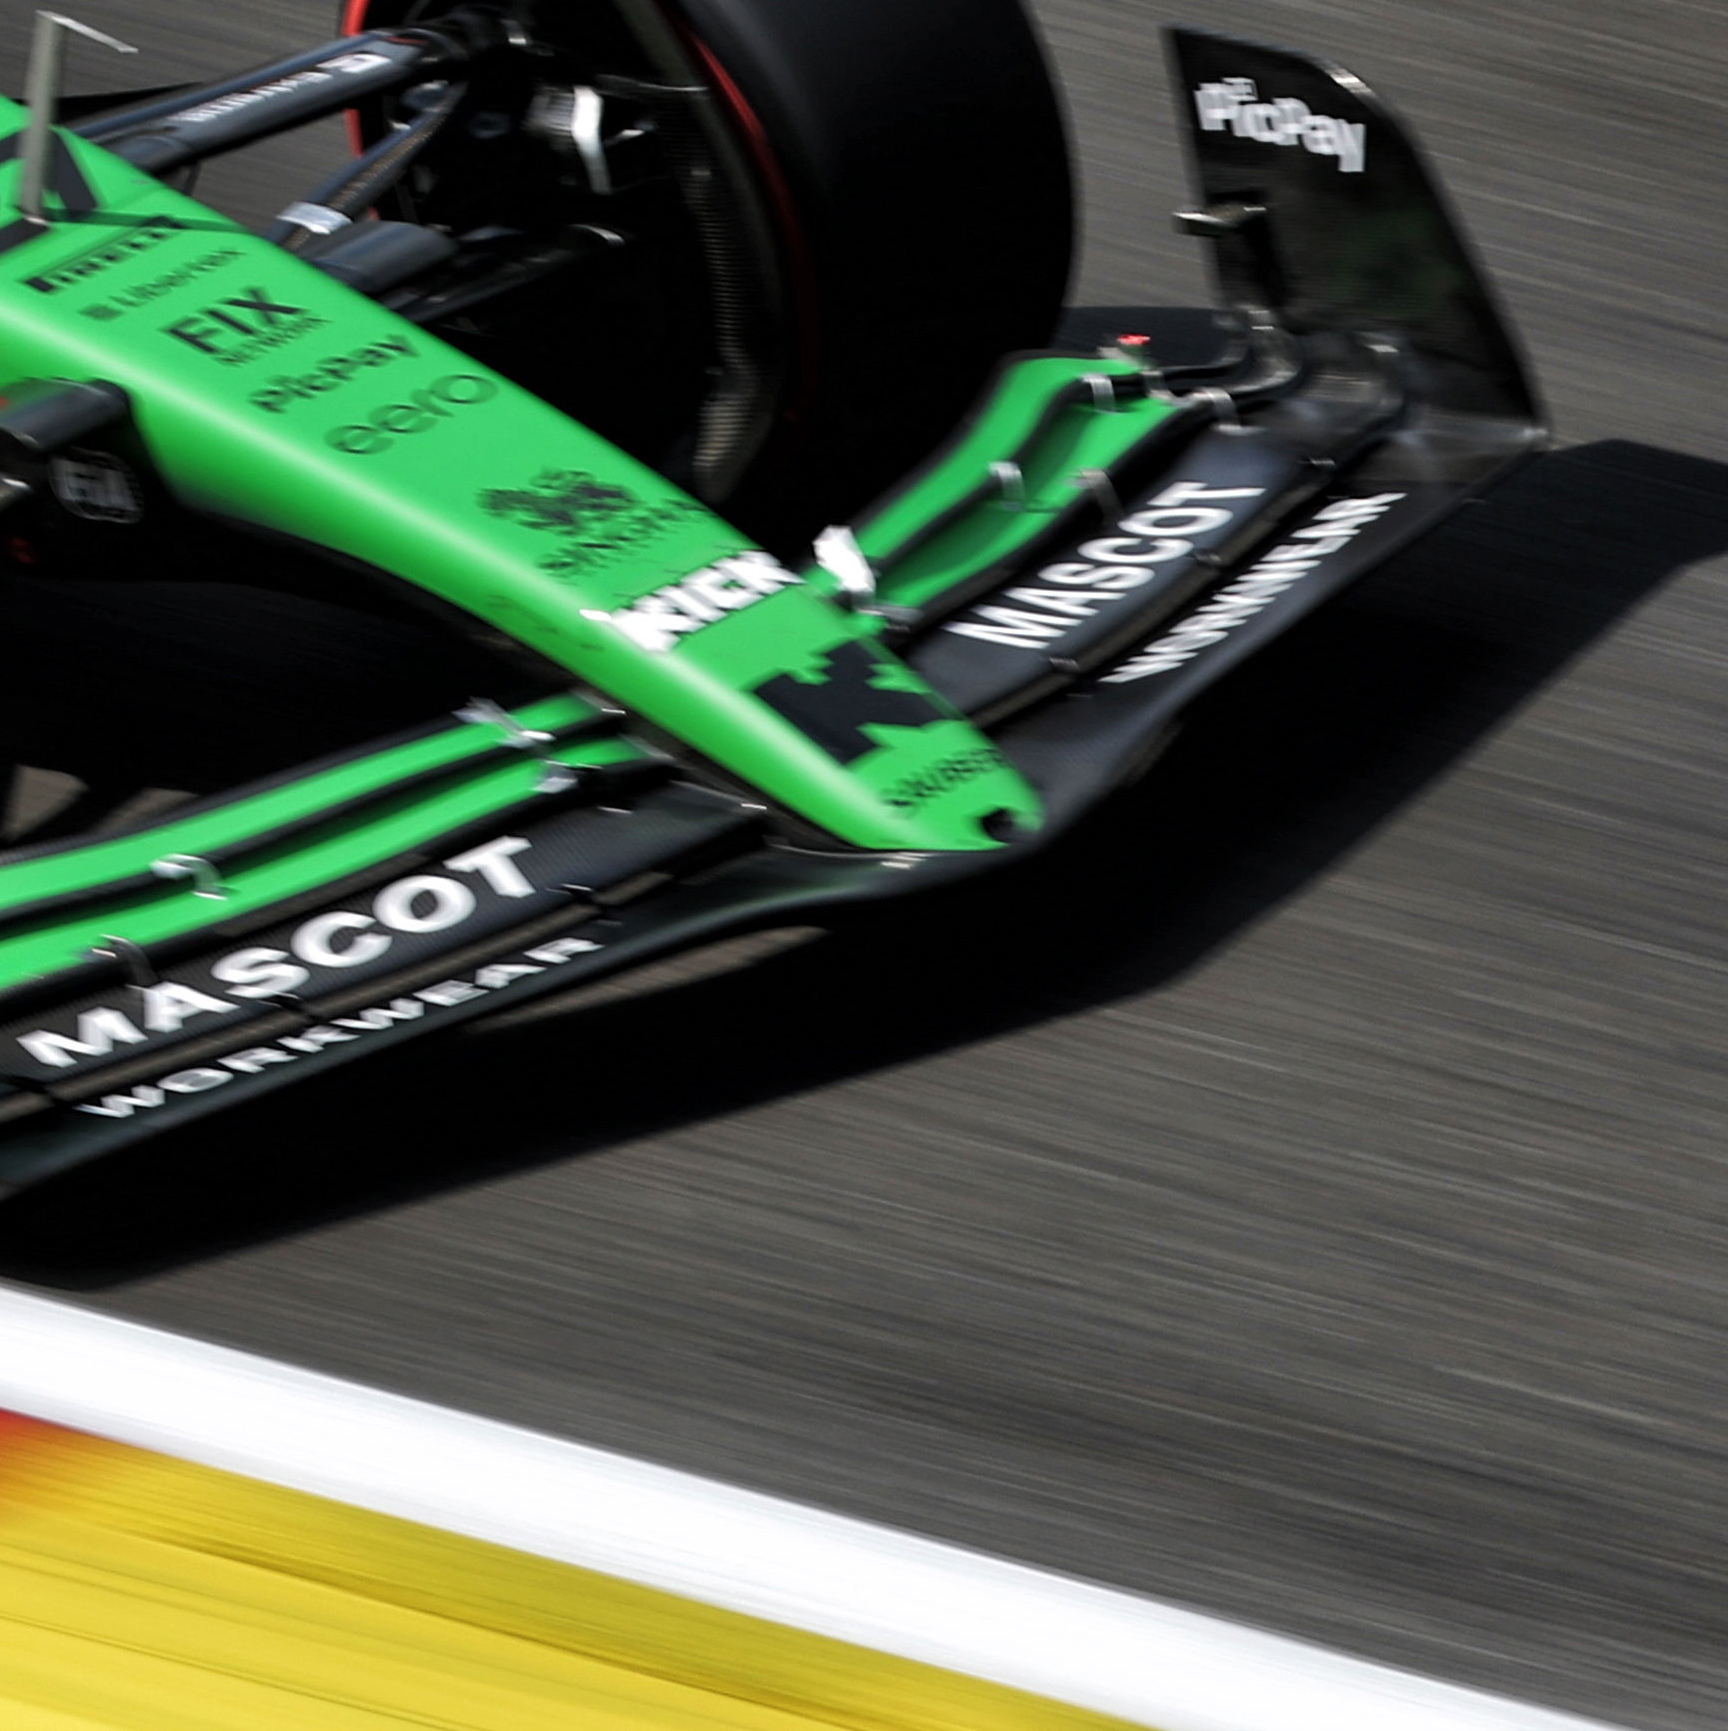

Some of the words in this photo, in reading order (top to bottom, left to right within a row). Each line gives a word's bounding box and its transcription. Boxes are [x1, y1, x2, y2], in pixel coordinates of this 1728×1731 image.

[158, 286, 313, 355] FIX
[324, 373, 500, 456] eero
[609, 550, 807, 653] KICK
[944, 481, 1266, 649] MASCOT
[16, 835, 536, 1069] MASCOT
[75, 937, 605, 1118] WORKWEAR
